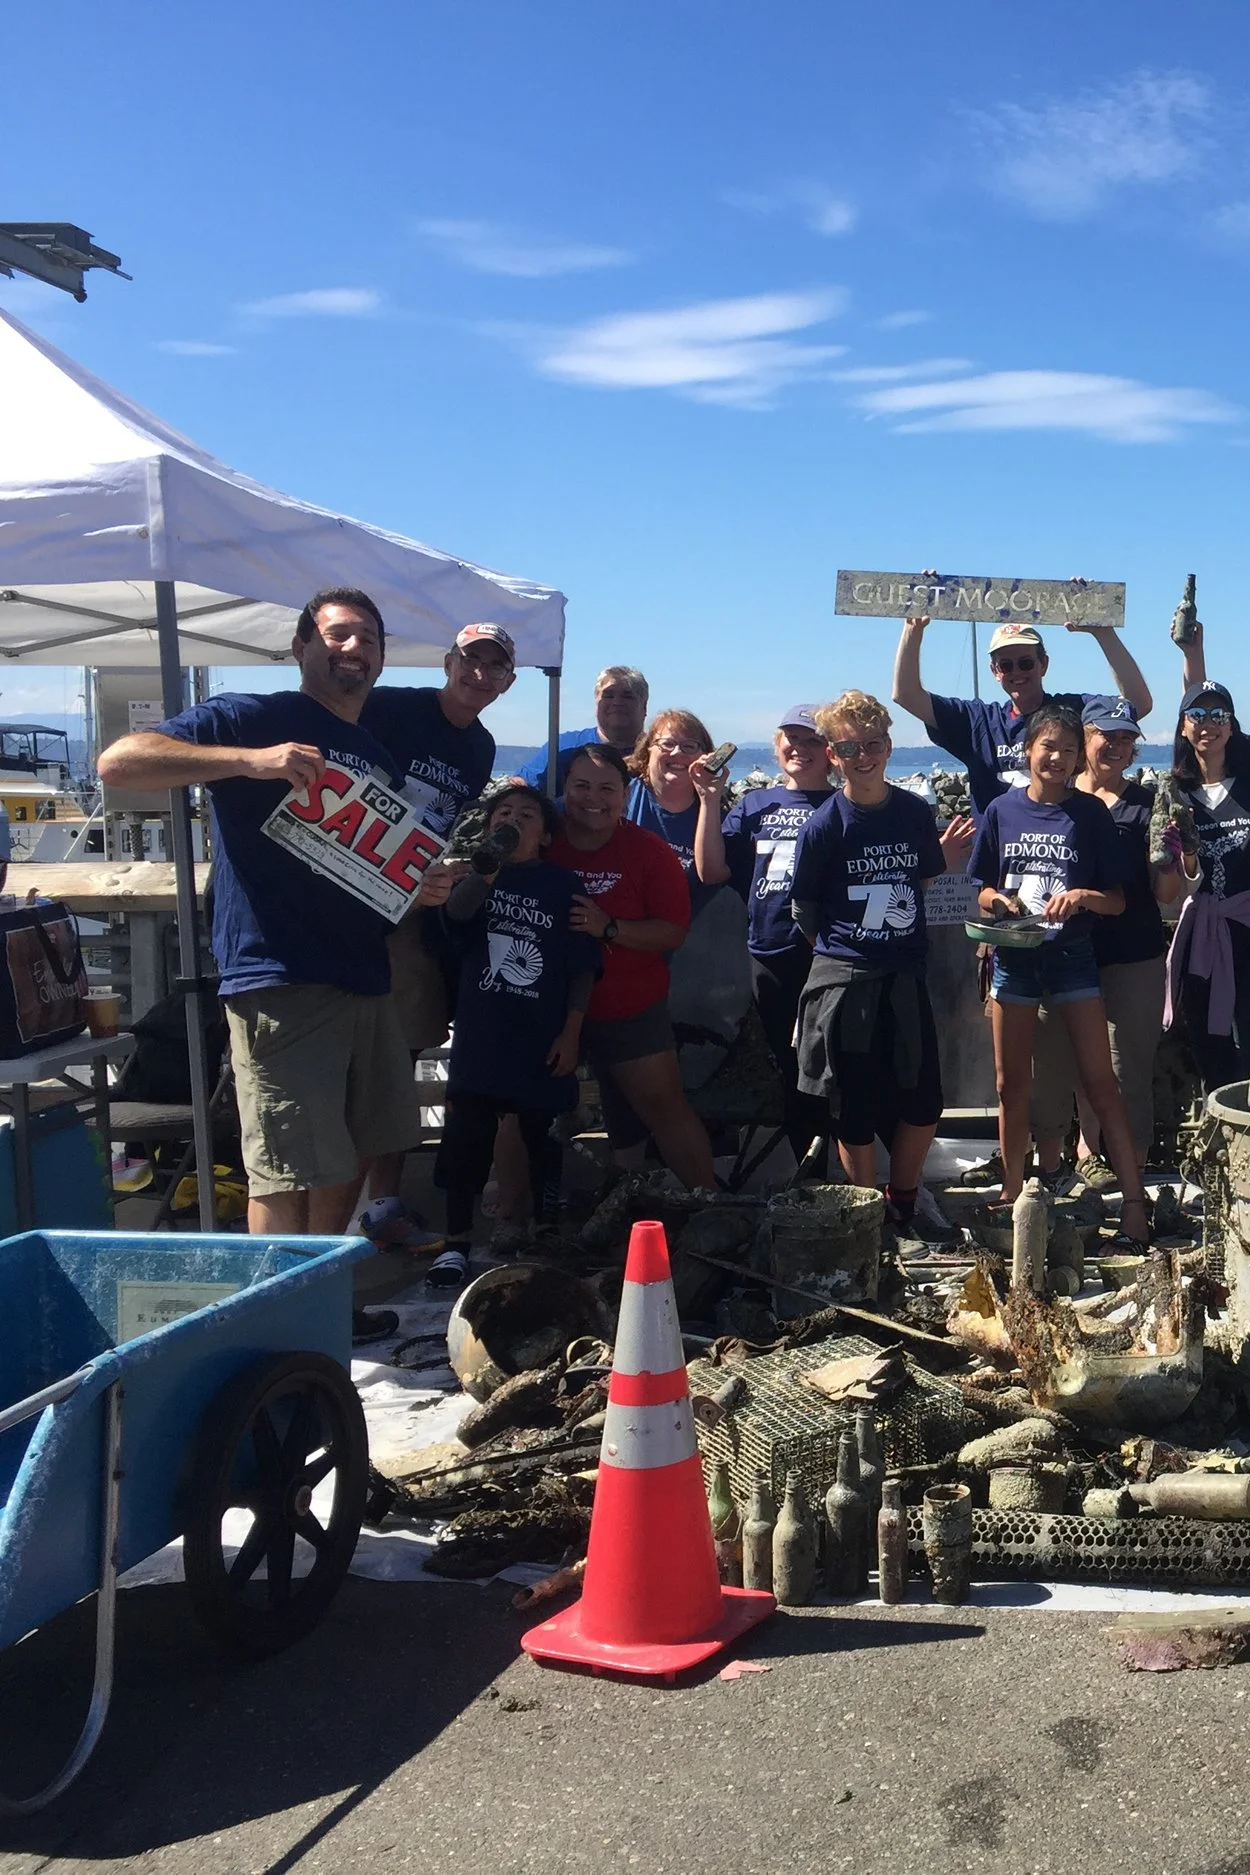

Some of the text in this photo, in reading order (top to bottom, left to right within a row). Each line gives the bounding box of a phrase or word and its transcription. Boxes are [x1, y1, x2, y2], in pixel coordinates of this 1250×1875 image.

[853, 583, 946, 607] GUEST
[329, 749, 360, 767] PORT
[408, 759, 470, 796] EDMONDS
[364, 786, 403, 822] FOR
[778, 808, 808, 817] PORT
[285, 767, 446, 895] SALE
[1220, 818, 1236, 828] and
[1020, 832, 1066, 844] PORT OF
[863, 842, 909, 857] PORT OF
[1004, 843, 1079, 863] EDMONDS
[1012, 860, 1067, 877] Celebrating
[493, 889, 539, 908] PORT OF
[484, 898, 553, 929] DMONDS
[849, 923, 891, 941] Years
